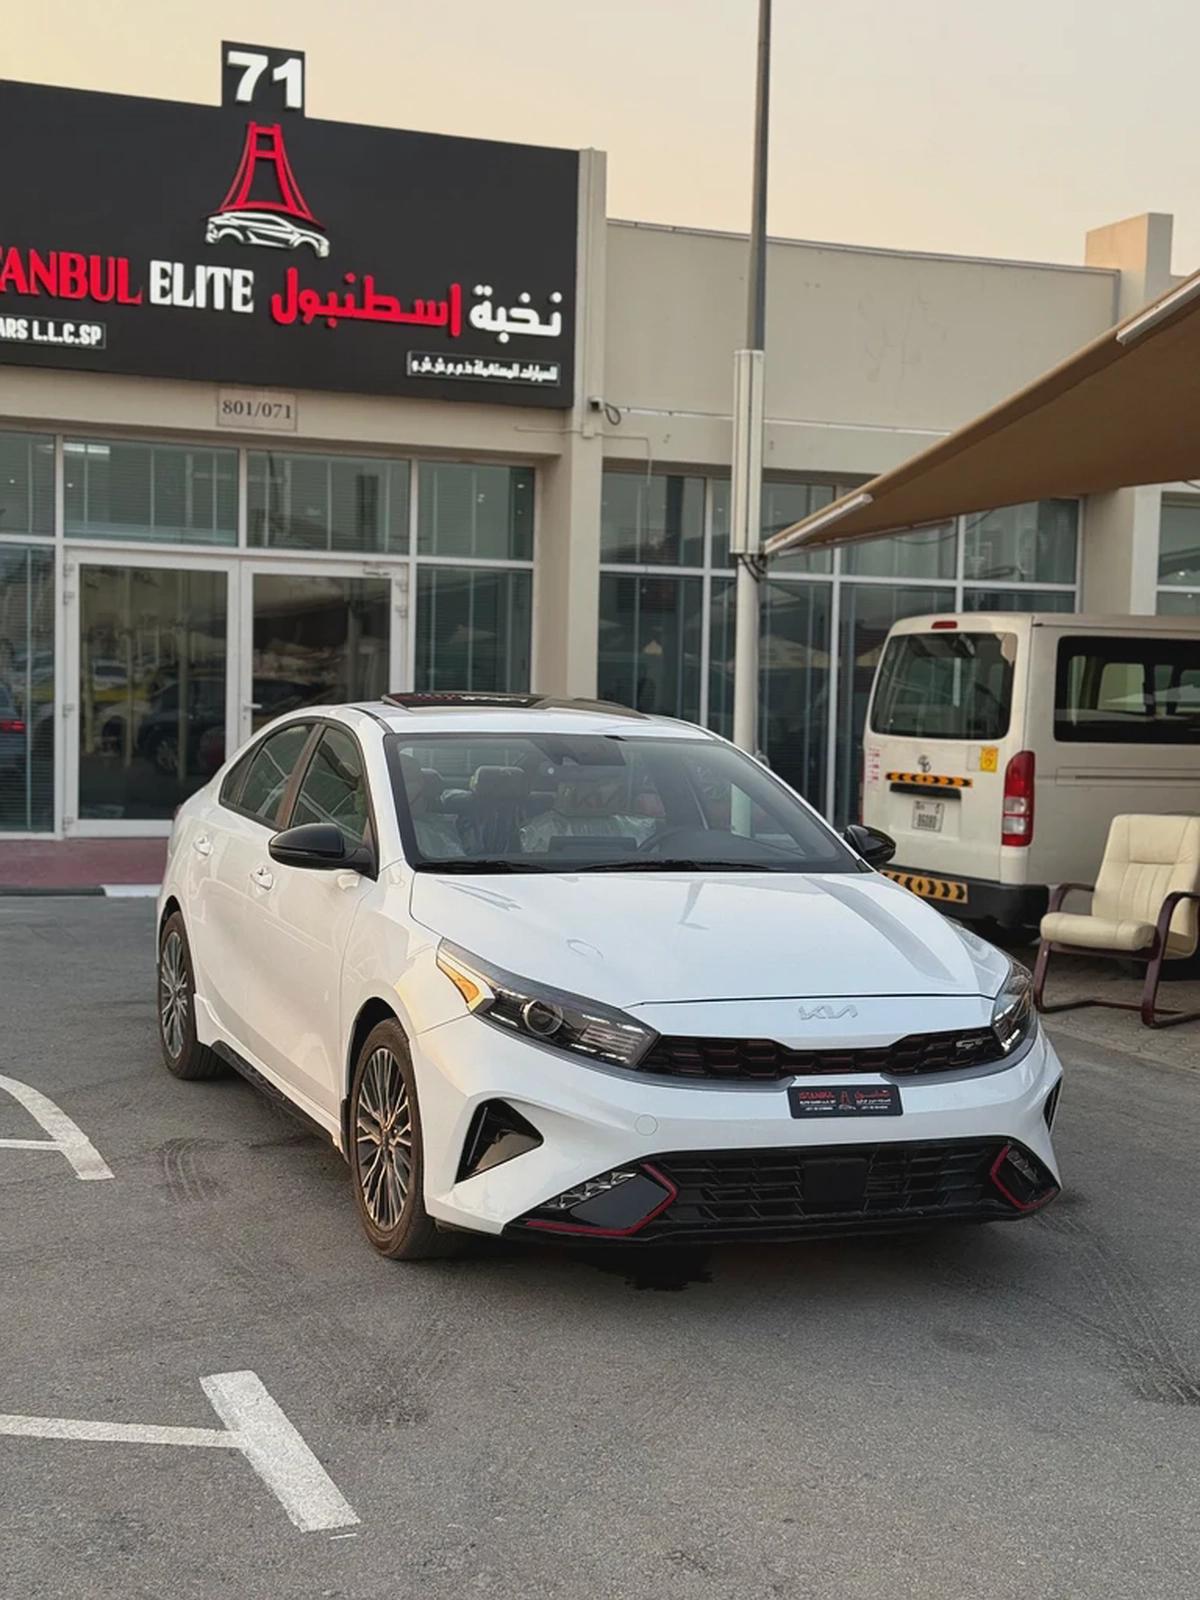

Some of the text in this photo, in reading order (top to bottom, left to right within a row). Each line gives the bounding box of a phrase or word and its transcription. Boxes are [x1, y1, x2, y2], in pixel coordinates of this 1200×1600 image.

[227, 50, 302, 108] 71
[0, 245, 254, 313] ANBUL ELITE
[271, 267, 562, 343] نخبة اسطنبول
[222, 400, 291, 419] 801/071
